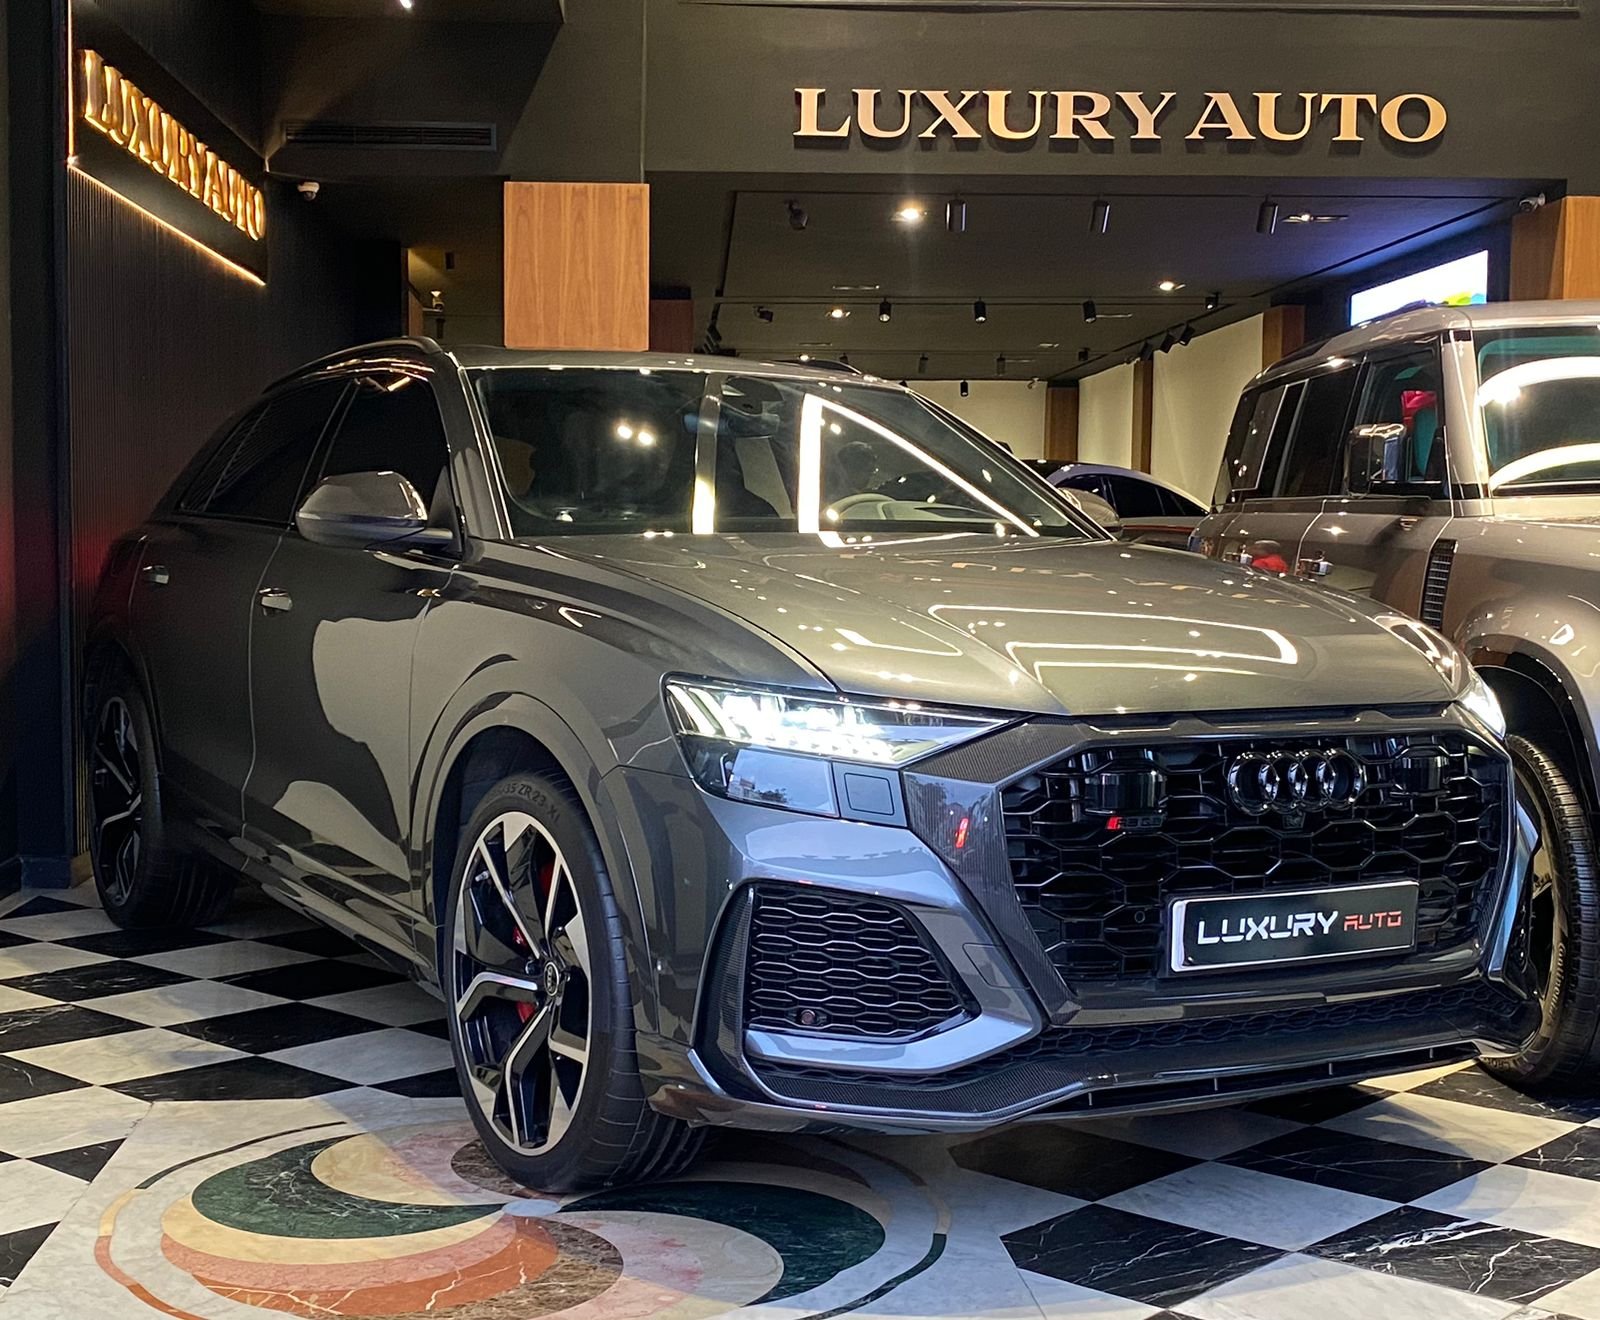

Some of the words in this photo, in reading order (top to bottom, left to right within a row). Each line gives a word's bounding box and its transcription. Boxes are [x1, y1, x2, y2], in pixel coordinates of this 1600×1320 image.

[792, 88, 1176, 140] LUXURY
[1185, 92, 1448, 143] AUTO
[1197, 911, 1339, 945] LUXURY
[1343, 910, 1402, 932] AUTO
